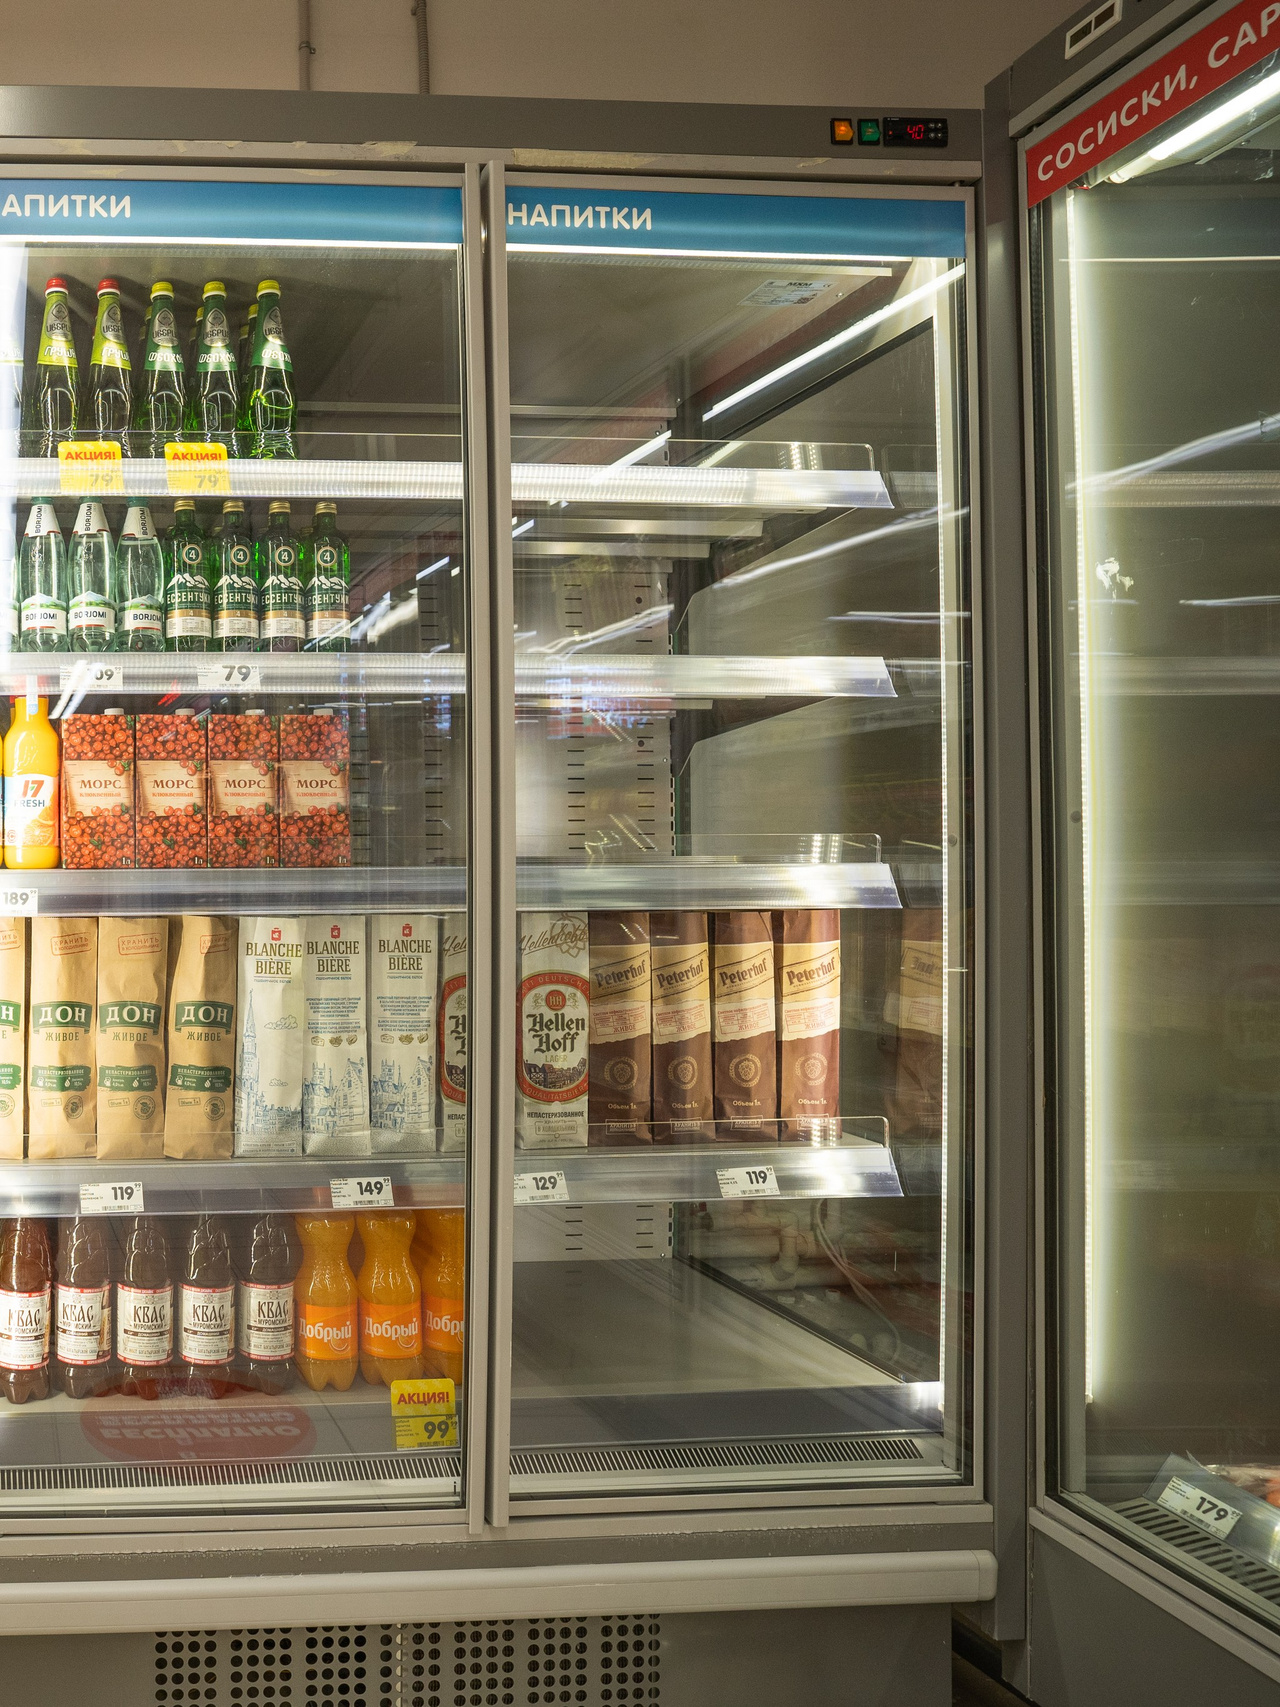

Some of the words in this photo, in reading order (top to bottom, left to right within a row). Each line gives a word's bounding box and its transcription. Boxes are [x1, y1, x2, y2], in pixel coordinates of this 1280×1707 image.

[1037, 64, 1198, 181] СОСИСКИ,
[1207, 2, 1280, 69] САР
[508, 203, 652, 231] НАПИТКИ
[65, 450, 116, 462] АКЦИЯ!
[171, 451, 222, 463] АКЦИЯ!
[89, 472, 114, 488] 79
[194, 473, 218, 488] 79
[34, 505, 43, 534] BORJOMI
[84, 503, 93, 532] BORJOMI
[142, 507, 150, 536] BORJOMI
[74, 610, 107, 620] BORJOMI
[222, 664, 252, 682] 79
[23, 779, 45, 798] J7
[79, 779, 122, 789] МОРС
[152, 779, 195, 789] МОРС
[224, 779, 266, 789] МОРС
[296, 779, 338, 789] МОРС
[2, 891, 29, 905] 189
[53, 936, 89, 946] ХРАНИТЬ
[120, 936, 160, 946] ХРАНИТЬ
[307, 940, 360, 955] BLANCHE
[378, 939, 432, 954] BLANCHE
[246, 942, 302, 958] BLANCHE
[255, 957, 292, 975] BIÈRE
[317, 955, 351, 973] BIÈRE
[388, 954, 423, 971] BIÈRE
[786, 956, 836, 986] Peterhof
[595, 959, 646, 989] Peterhof
[656, 958, 704, 989] Peterhof
[719, 957, 768, 987] Peterhof
[38, 1005, 86, 1024] ДОН
[106, 1005, 155, 1024] ДОН
[181, 1005, 227, 1024] ДОН
[526, 1012, 586, 1034] Hellen
[45, 1031, 80, 1042] ЖИВОЕ
[112, 1031, 148, 1042] ЖИВОЕ
[187, 1030, 222, 1042] ЖИВОЕ
[532, 1032, 580, 1054] Hoff
[545, 1055, 568, 1063] LAGER
[527, 1111, 585, 1119] НЕПАСТЕРИЗОВАННОЕ
[532, 1176, 558, 1191] 129
[746, 1170, 768, 1185] 119
[111, 1186, 135, 1201] 119
[357, 1180, 383, 1196] 149
[62, 1303, 94, 1323] КВАС
[133, 1304, 166, 1324] КВАС
[193, 1304, 225, 1323] КВАС
[257, 1300, 289, 1319] КВАС
[133, 1323, 164, 1331] МУРОМСКИЙ
[299, 1318, 352, 1343] Добрый
[365, 1317, 419, 1341] Добрый
[397, 1392, 450, 1406] АКЦИЯ!
[423, 1421, 450, 1440] 99
[1195, 1496, 1228, 1522] 179
